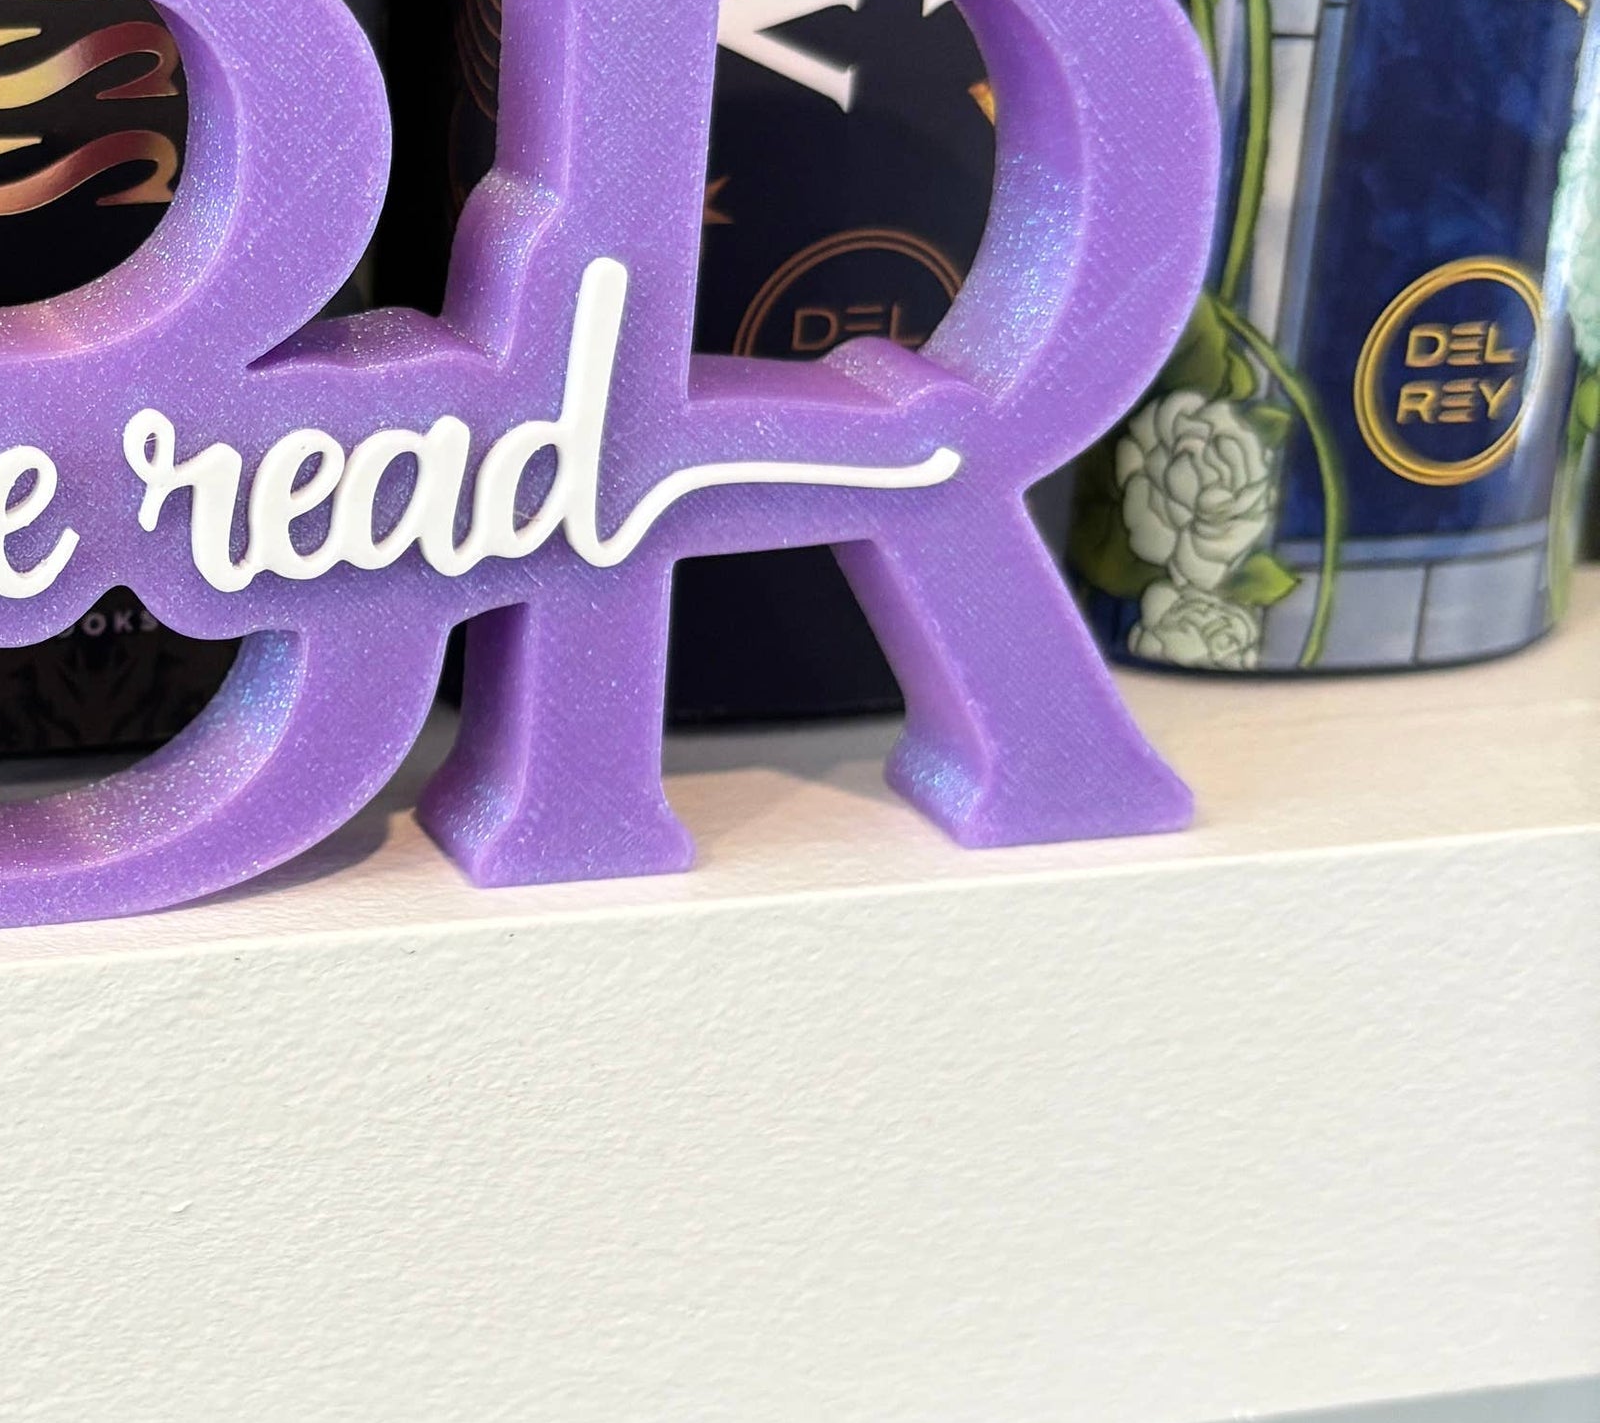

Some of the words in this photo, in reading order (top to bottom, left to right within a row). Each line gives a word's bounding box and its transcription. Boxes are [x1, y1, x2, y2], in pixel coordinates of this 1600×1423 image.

[1404, 320, 1517, 368] DEL
[123, 257, 961, 592] read
[1396, 377, 1513, 425] REY
